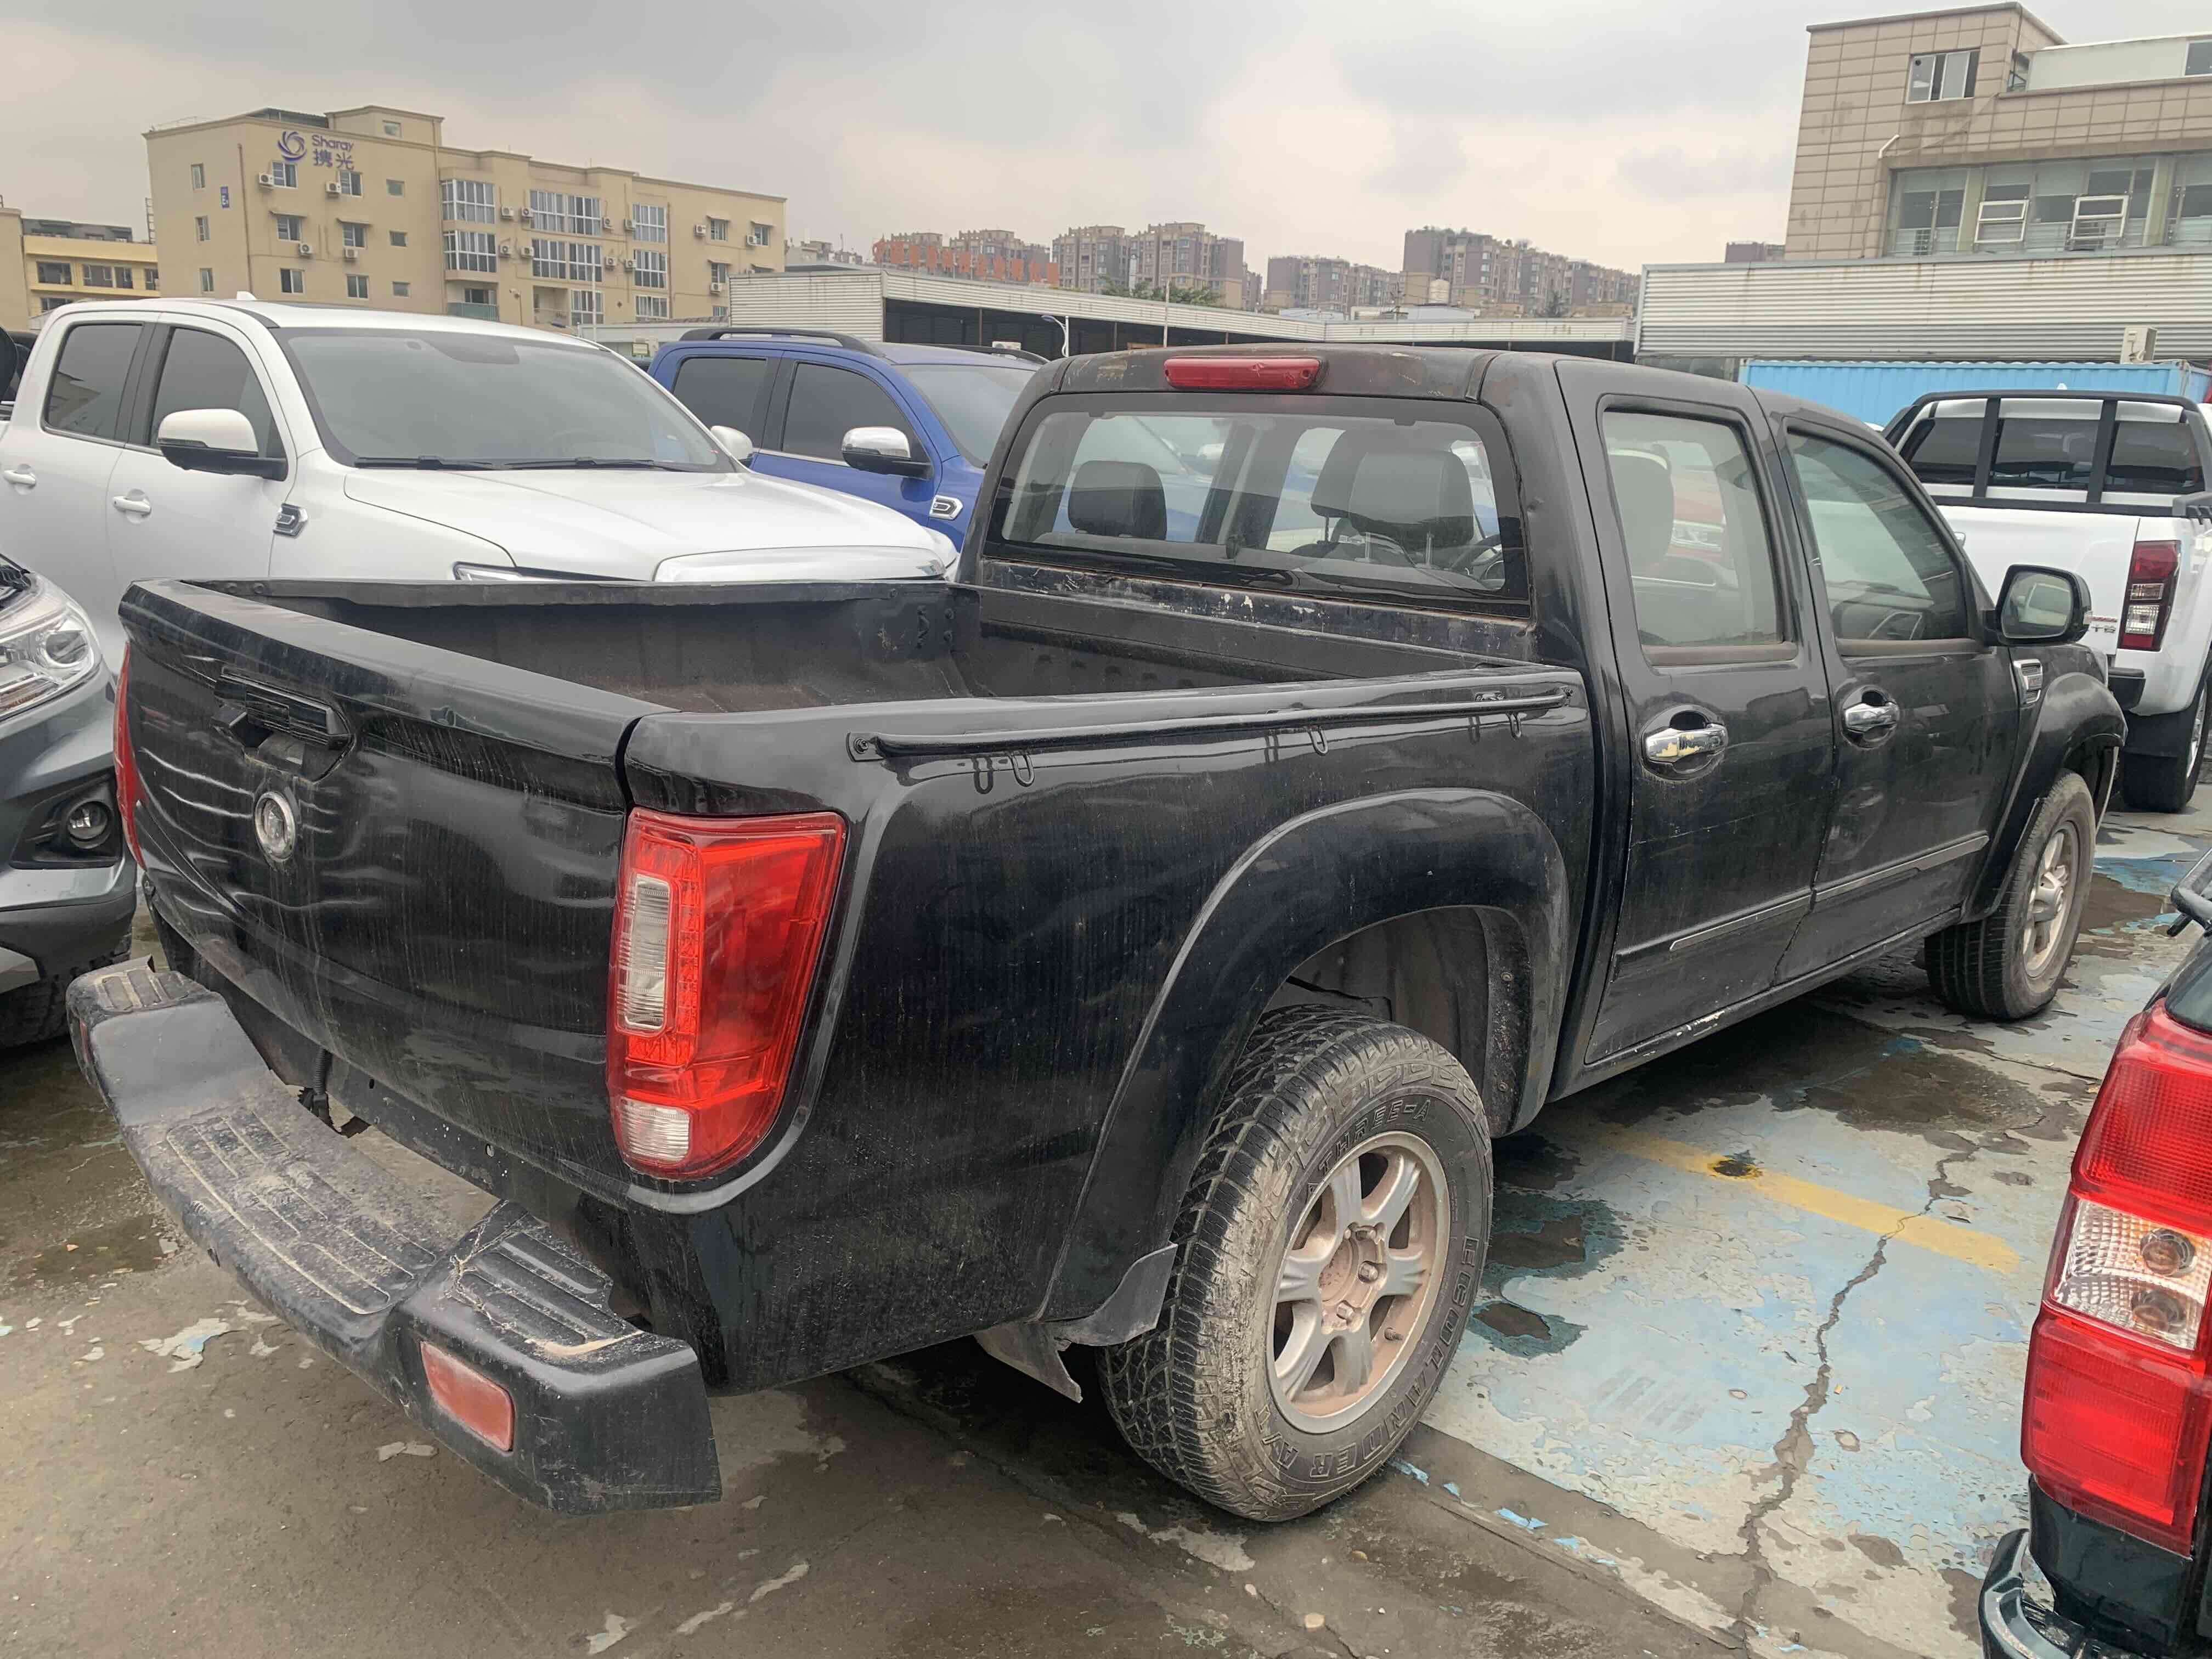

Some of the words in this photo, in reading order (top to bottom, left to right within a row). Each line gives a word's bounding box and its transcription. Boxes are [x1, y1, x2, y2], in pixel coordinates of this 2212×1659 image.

[312, 134, 354, 151] Sharay
[1318, 1098, 1431, 1175] THREE-A
[1309, 1237, 1480, 1477] ECOLANDER
